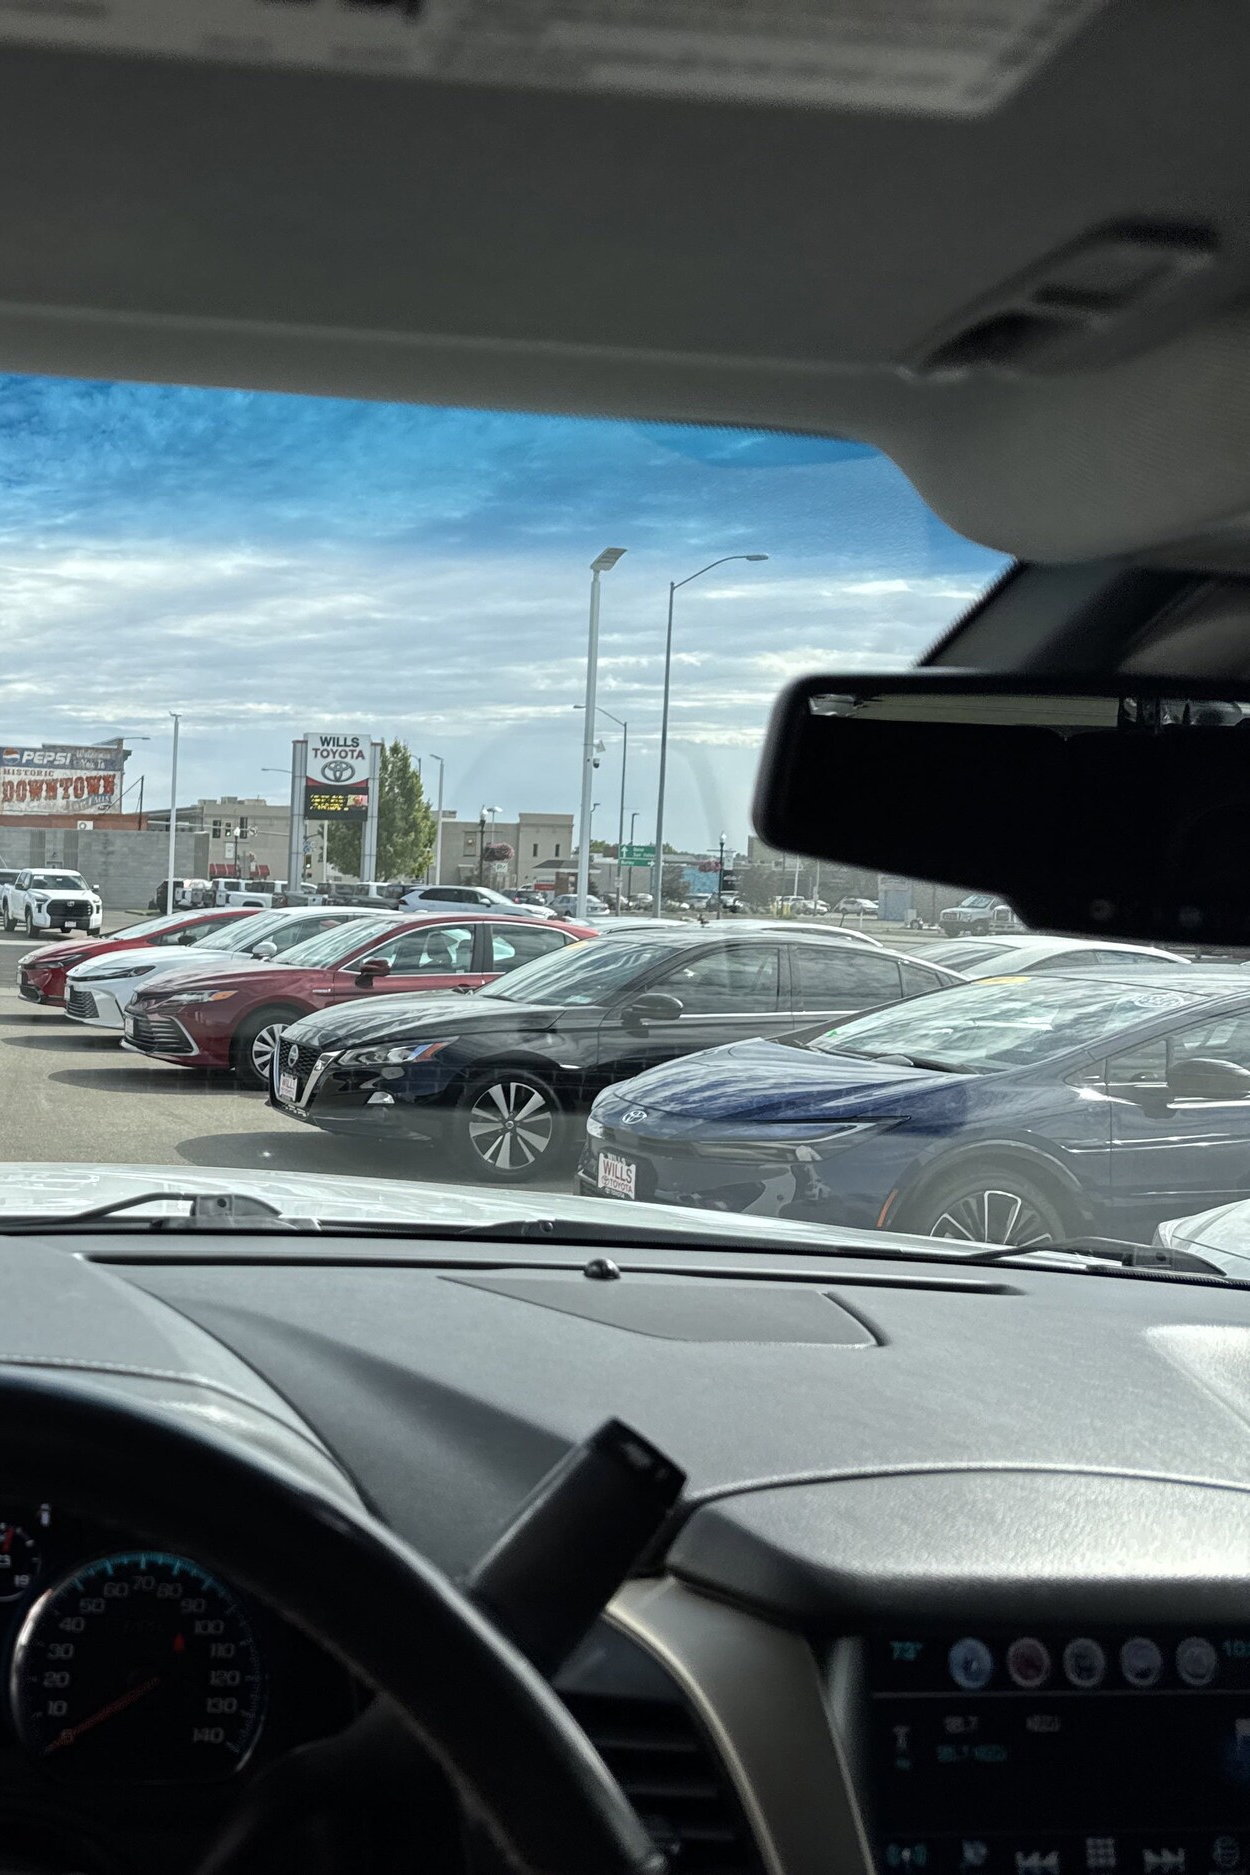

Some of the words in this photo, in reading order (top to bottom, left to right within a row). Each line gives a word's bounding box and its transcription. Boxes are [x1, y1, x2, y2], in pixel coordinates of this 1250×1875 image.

[320, 736, 360, 748] WILLS
[22, 751, 71, 765] PEPSI
[312, 748, 365, 760] TOYOTA
[3, 768, 54, 776] HISTORIC
[2, 774, 116, 803] DOWNTOWN
[603, 1159, 632, 1184] WILLS
[609, 1178, 633, 1194] TOYOTA
[14, 1575, 29, 1587] 19
[43, 1671, 70, 1687] 20
[48, 1700, 68, 1717] 10
